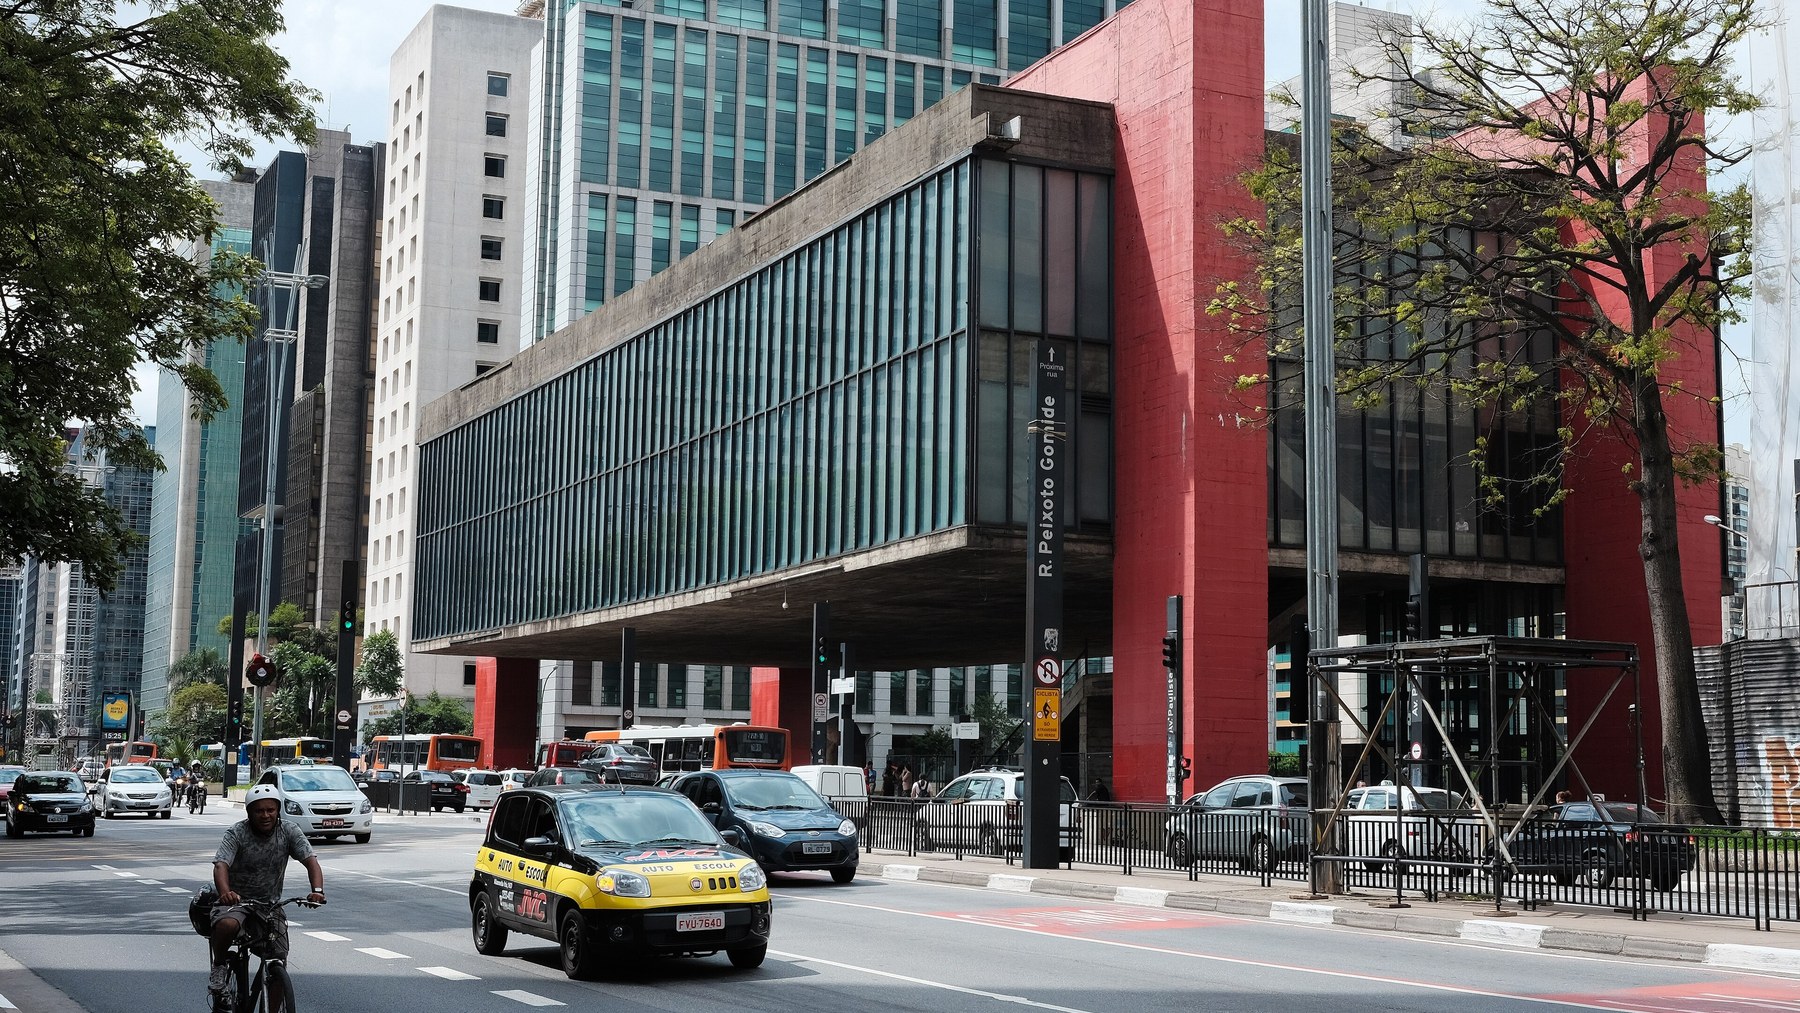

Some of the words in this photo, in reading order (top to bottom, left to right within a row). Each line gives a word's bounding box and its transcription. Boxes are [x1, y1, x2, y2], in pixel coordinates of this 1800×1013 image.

[1040, 362, 1064, 371] Próxima
[1040, 395, 1056, 471] Gomide
[1039, 477, 1054, 554] Peixoto
[1039, 560, 1053, 577] R.
[498, 858, 513, 873] AUTO
[525, 866, 548, 883] ESCOLA
[641, 865, 674, 873] AUTO
[694, 862, 736, 870] ESCOLA
[518, 888, 547, 921] JVC
